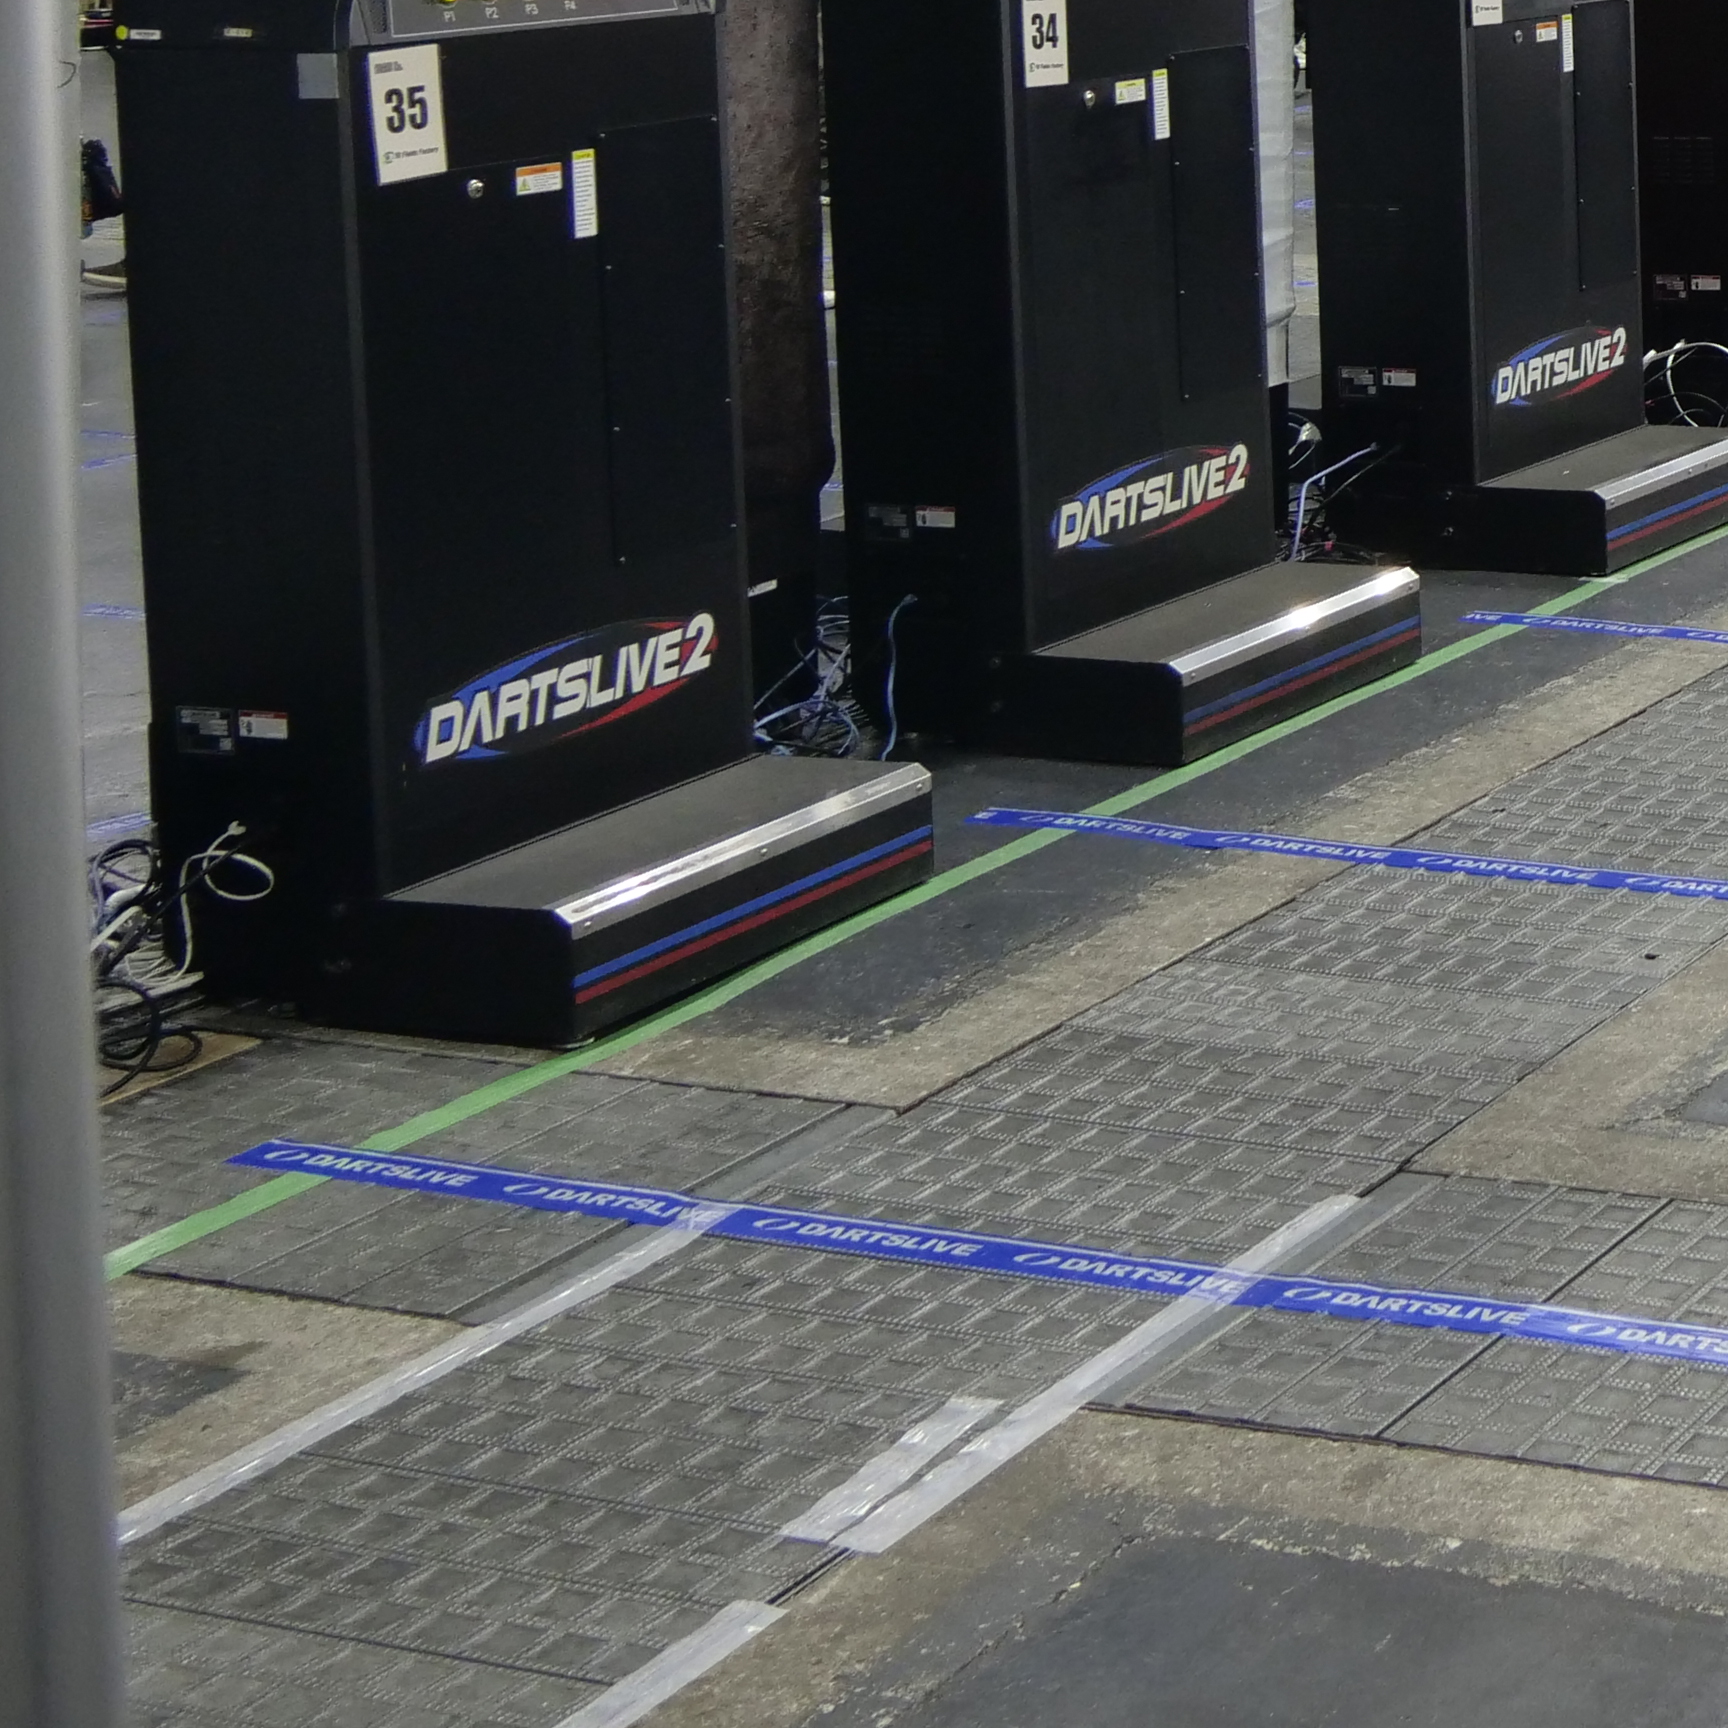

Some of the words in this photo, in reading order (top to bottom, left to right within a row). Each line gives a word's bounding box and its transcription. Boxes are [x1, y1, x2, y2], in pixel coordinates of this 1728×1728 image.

[1031, 12, 1059, 51] 34
[384, 85, 428, 134] 35
[1495, 327, 1627, 406] DARTSLIVE2
[1057, 443, 1250, 549] DARTSLIVE2
[425, 612, 717, 764] DARTSLIVE2
[1051, 815, 1194, 842] DARTSLIVE
[1249, 835, 1391, 860] DARTSLIVE
[1452, 858, 1600, 882] DARTSLIVE
[302, 1151, 479, 1189] DARTSLIVE
[546, 1186, 719, 1225] DARTSLIVE
[796, 1217, 981, 1259] DARTSLIVE
[1058, 1252, 1242, 1295] DARTSLIVE
[1330, 1289, 1530, 1327] DARTSLIVE
